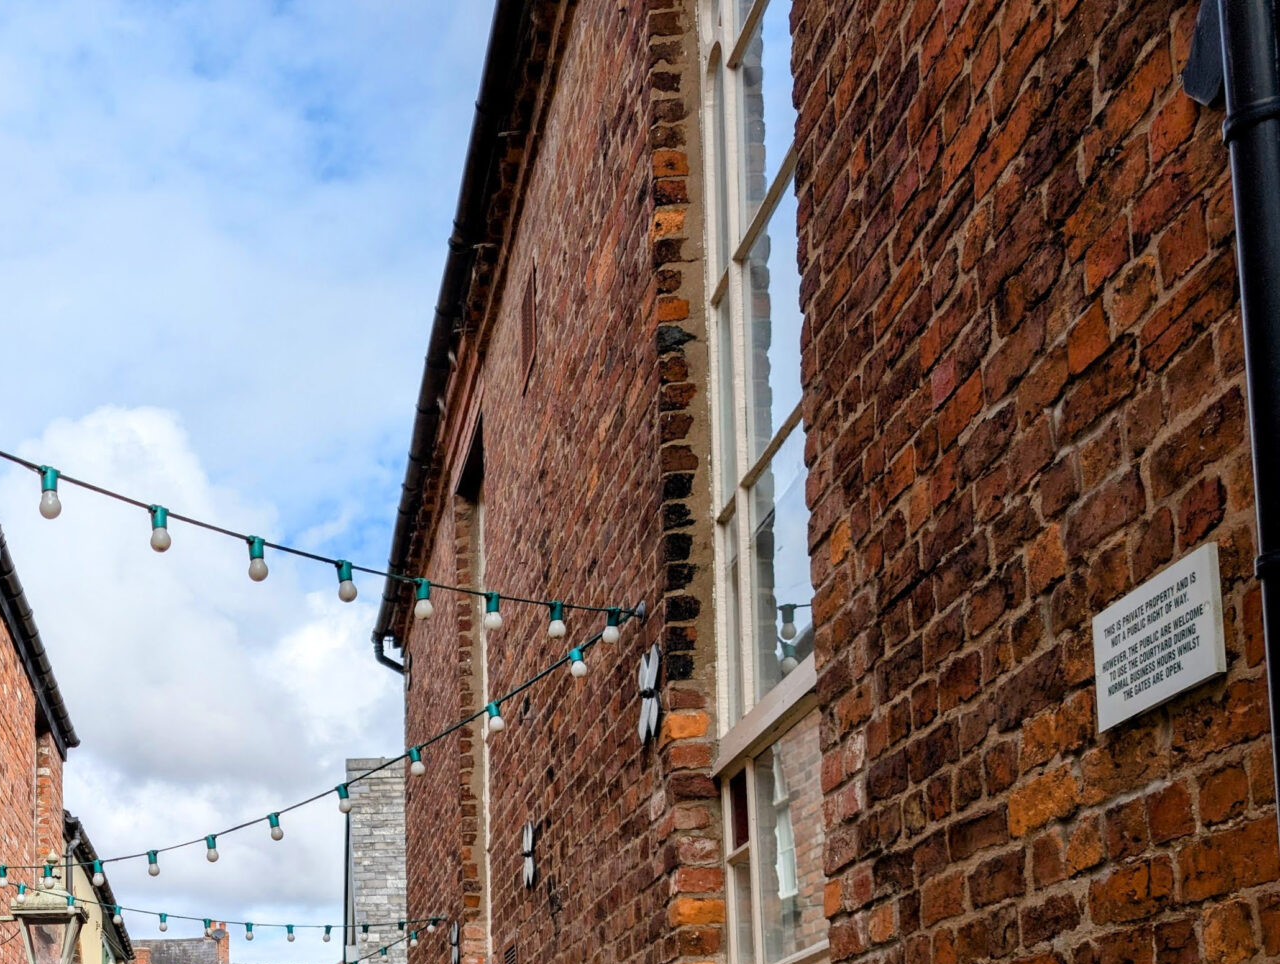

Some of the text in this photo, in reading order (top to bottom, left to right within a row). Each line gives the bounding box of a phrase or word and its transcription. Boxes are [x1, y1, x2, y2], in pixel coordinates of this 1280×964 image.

[1104, 571, 1196, 639] THIS IS PRIVATE PROPERTY AND IS
[1111, 591, 1189, 648] NOT A PUBLIC RIGHT OF WAY.
[1102, 603, 1203, 673] HOWEVER, THE PUBLIC ARE WELCOME
[1108, 635, 1200, 697] NORMAL BUSINESS HOURS WHILST
[1109, 622, 1196, 682] TO USE THE COURTYARD DURING
[1123, 660, 1184, 701] THE GATES ARE OPEN.
